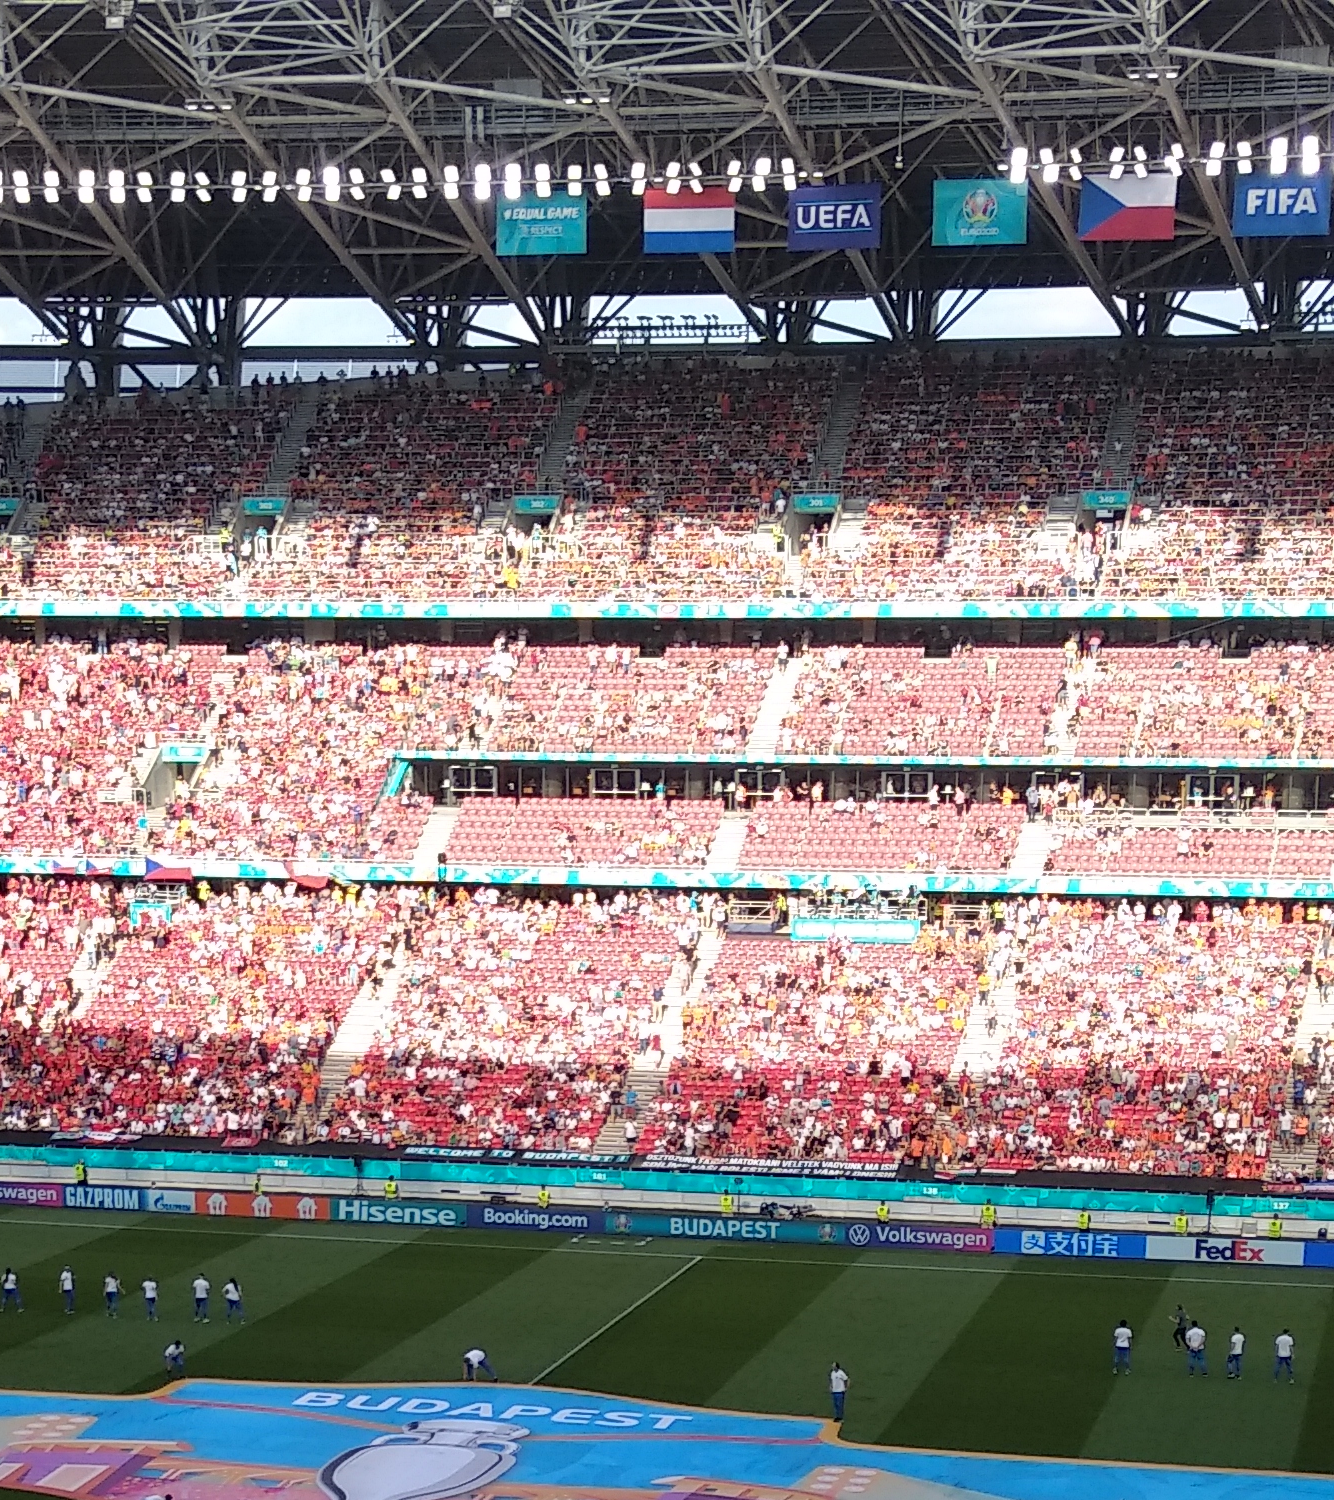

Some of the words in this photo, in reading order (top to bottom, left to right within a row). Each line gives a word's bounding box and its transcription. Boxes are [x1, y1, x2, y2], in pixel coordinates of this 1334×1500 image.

[1246, 187, 1317, 215] FIFA
[547, 206, 580, 220] GAME
[796, 204, 871, 230] UEFA
[404, 1147, 485, 1157] WELCOME
[489, 1149, 516, 1158] TO
[521, 1151, 616, 1162] BUDAPEST
[65, 1186, 140, 1210] GAZPROM
[339, 1199, 457, 1226] Hisense
[483, 1208, 588, 1229] Booking.com
[669, 1218, 780, 1240] BUDAPEST
[875, 1226, 987, 1249] Volkswagen
[1047, 1232, 1119, 1258] 支付宝
[1195, 1239, 1265, 1262] FedEx
[291, 1390, 694, 1431] BUDAPEST
